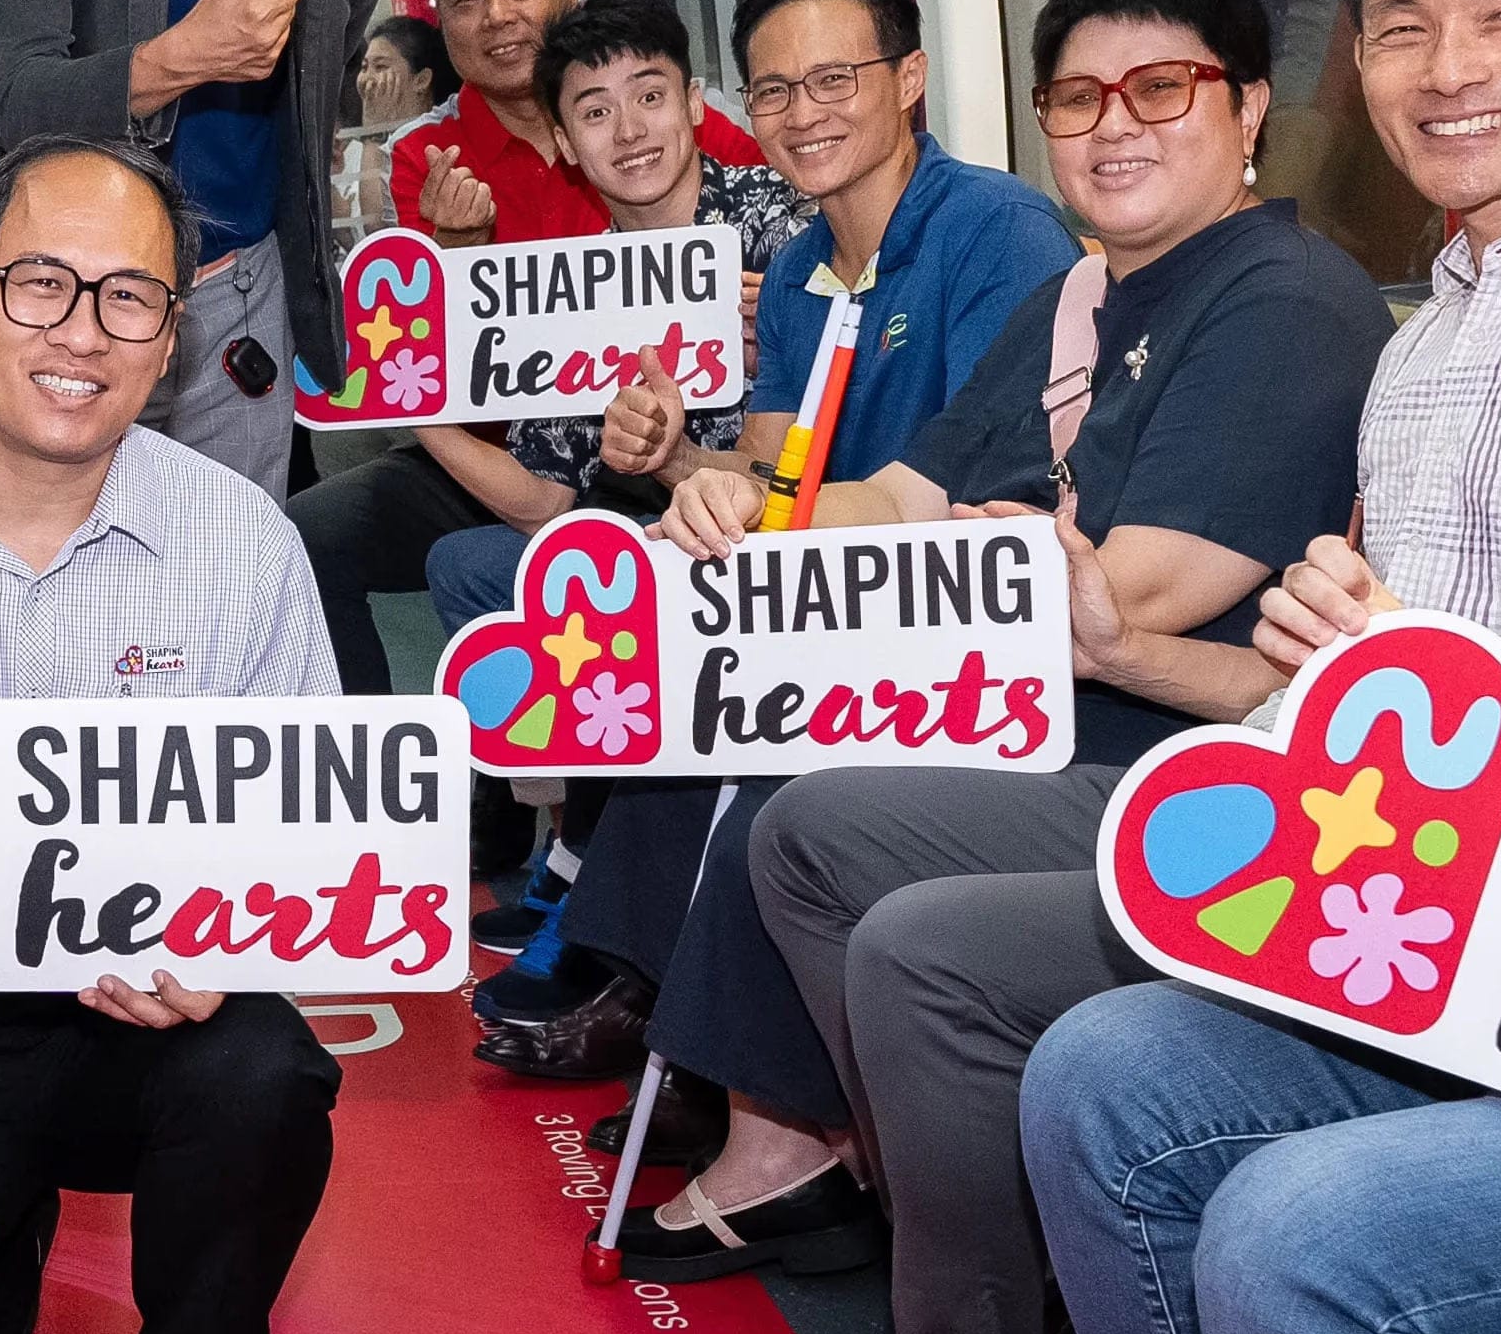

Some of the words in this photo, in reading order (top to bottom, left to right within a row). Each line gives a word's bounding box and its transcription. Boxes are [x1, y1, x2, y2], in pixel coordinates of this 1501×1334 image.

[469, 239, 717, 319] SHAPING
[469, 322, 727, 407] hearts
[691, 535, 1033, 637] SHAPING
[146, 647, 183, 658] SHAPING
[146, 658, 185, 671] hearts
[693, 646, 1051, 760] hearts
[18, 722, 439, 826] SHAPING
[15, 838, 453, 976] hearts
[534, 1113, 575, 1126] 3
[542, 1130, 610, 1200] Roving
